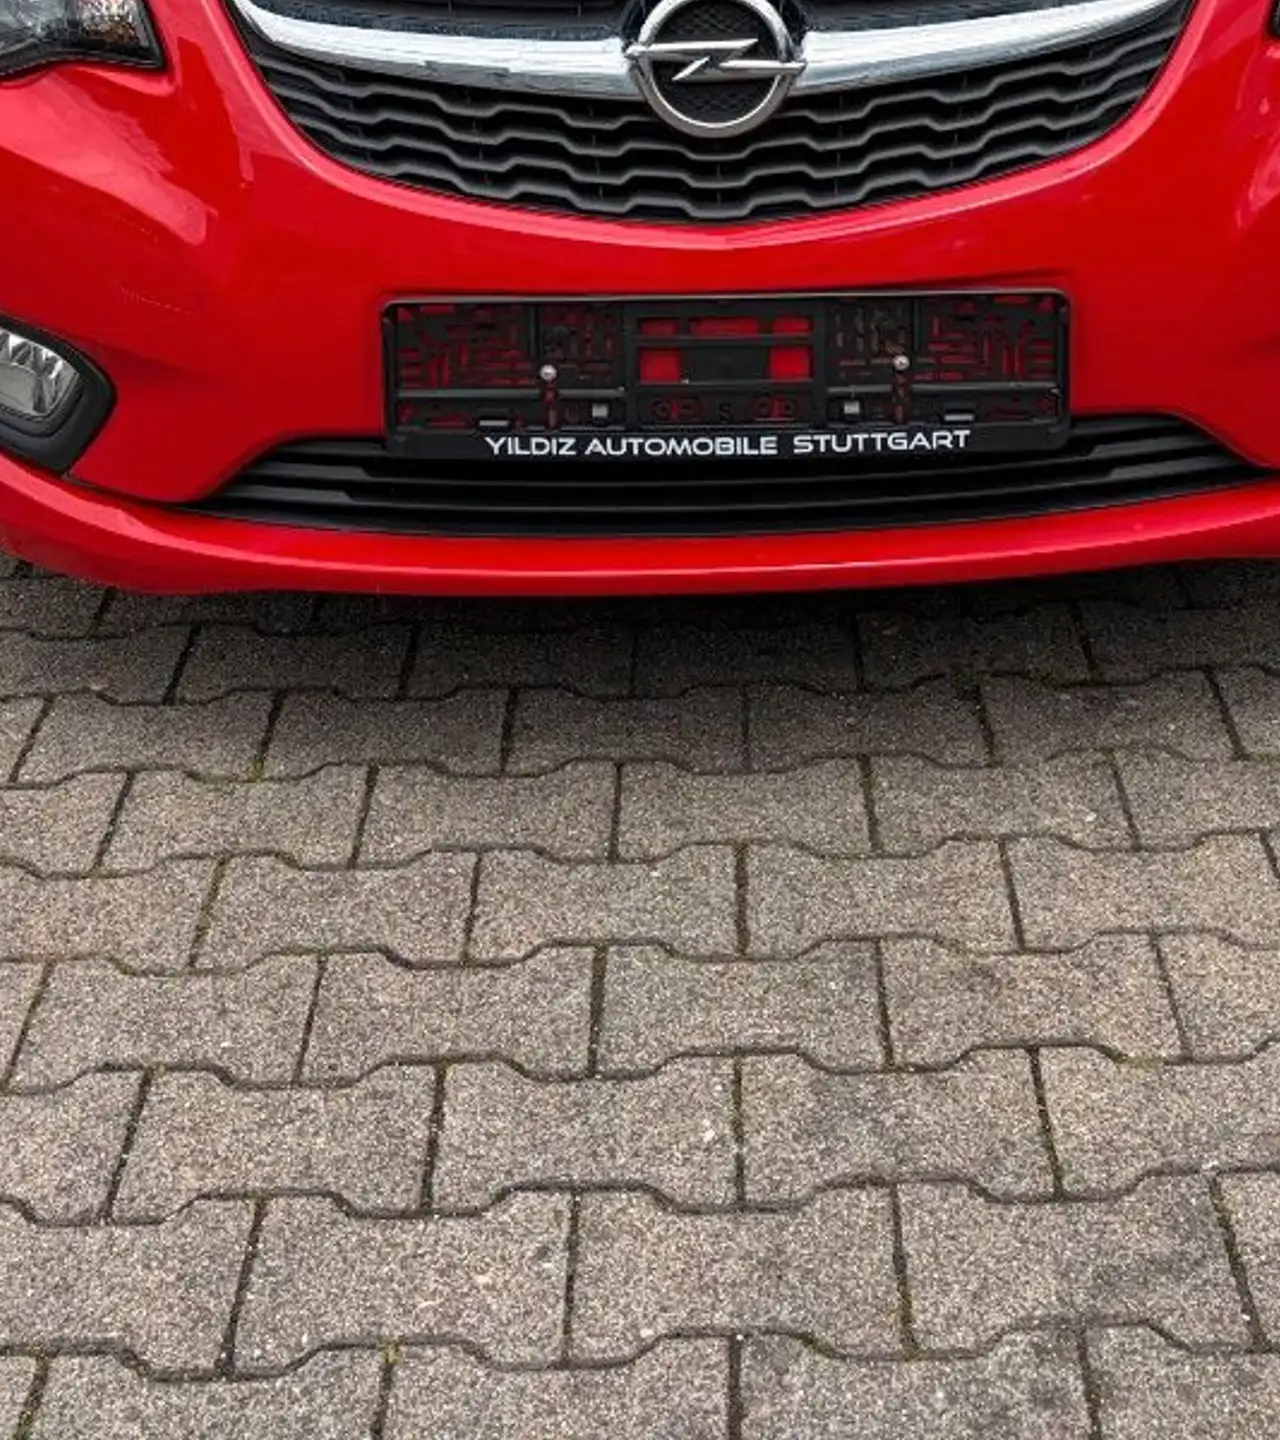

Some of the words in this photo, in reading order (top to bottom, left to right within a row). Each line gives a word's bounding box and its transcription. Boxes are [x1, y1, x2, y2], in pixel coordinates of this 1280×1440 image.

[484, 436, 577, 456] YILDIZ
[584, 435, 778, 456] AUTOMOBILE
[792, 429, 970, 455] STUTTGART
